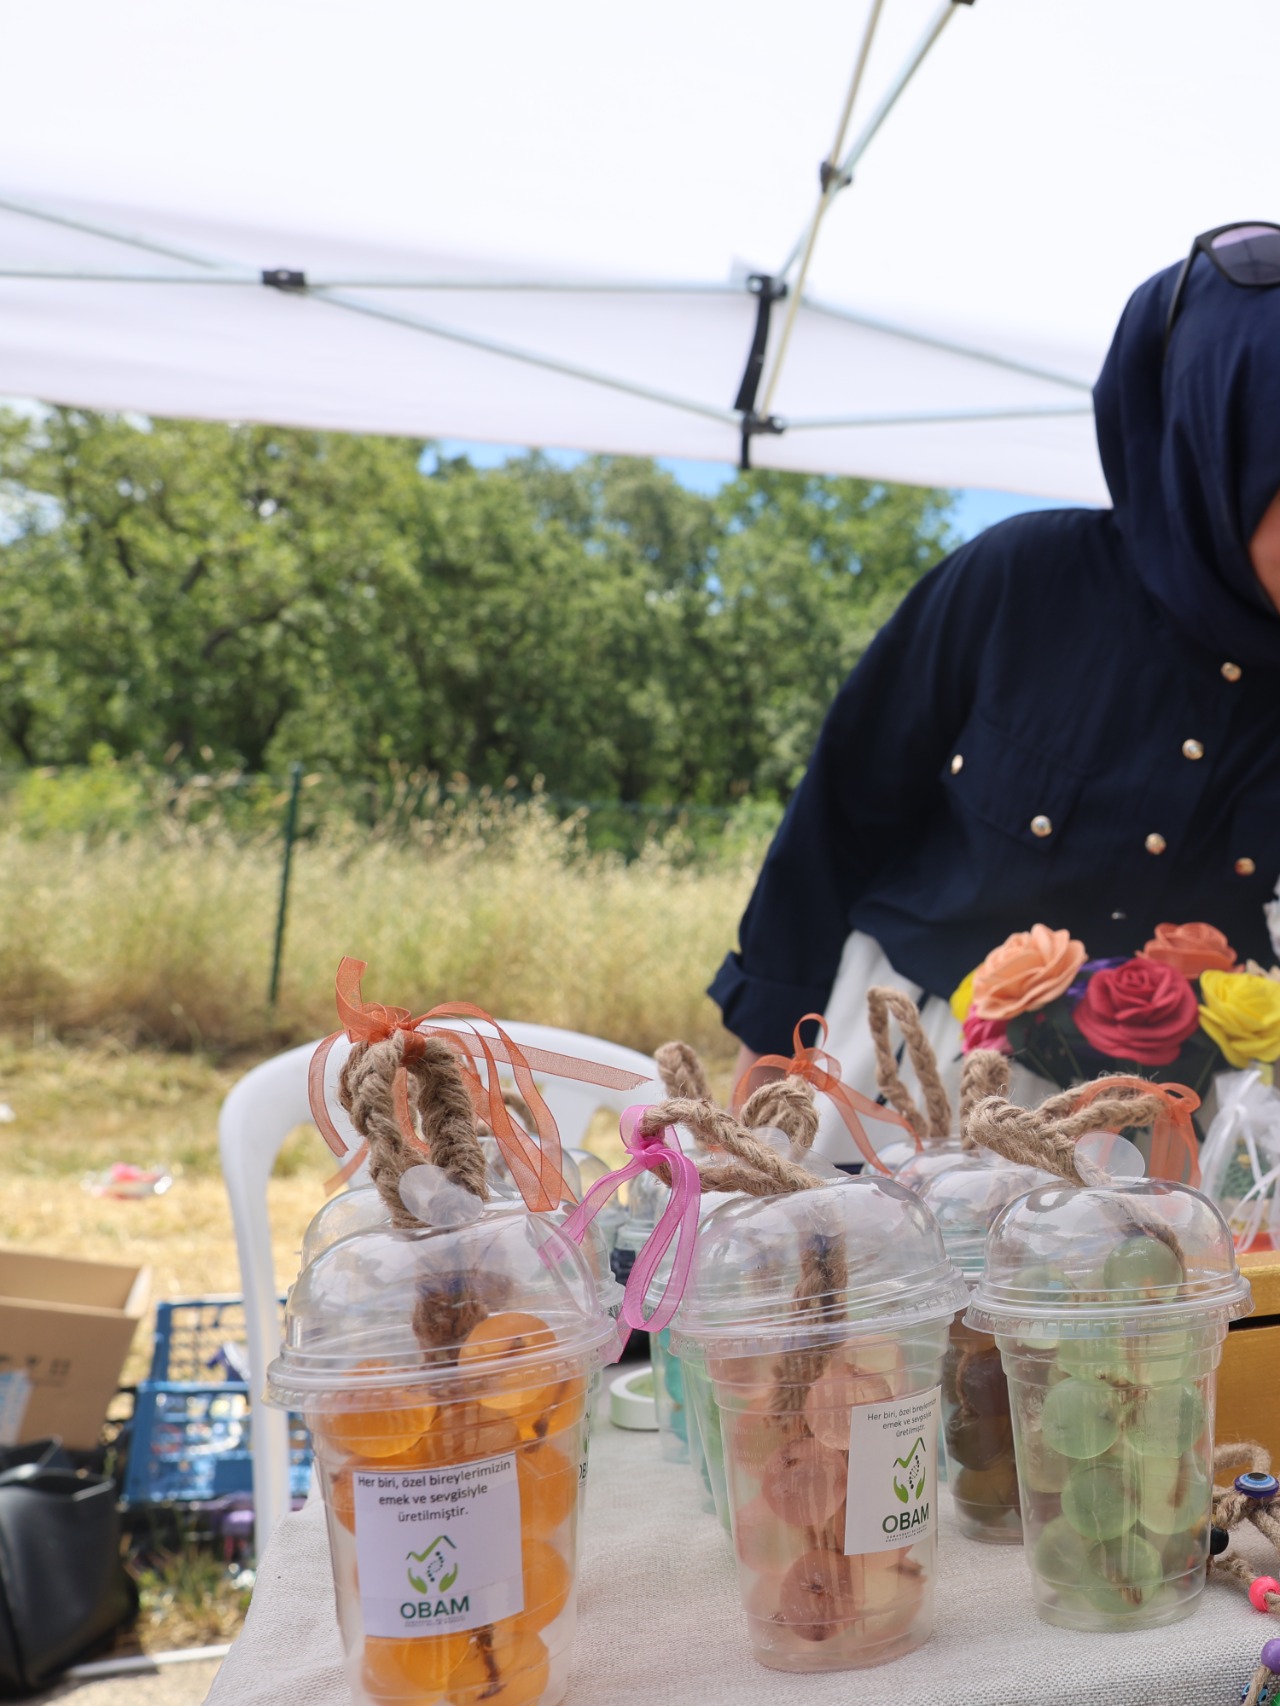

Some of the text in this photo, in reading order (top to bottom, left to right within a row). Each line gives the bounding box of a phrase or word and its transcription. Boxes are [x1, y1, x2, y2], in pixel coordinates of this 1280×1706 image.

[867, 1413, 881, 1421] Her
[884, 1410, 897, 1419] biri,
[882, 1420, 902, 1429] emek
[904, 1418, 910, 1426] ve
[358, 1461, 511, 1490] Her biri, özel bireylerimizin
[379, 1484, 488, 1505] emek ve sevgisiyle
[398, 1505, 469, 1522] üretilmiştir.
[882, 1502, 929, 1533] OBAM
[400, 1595, 469, 1619] OBAM
